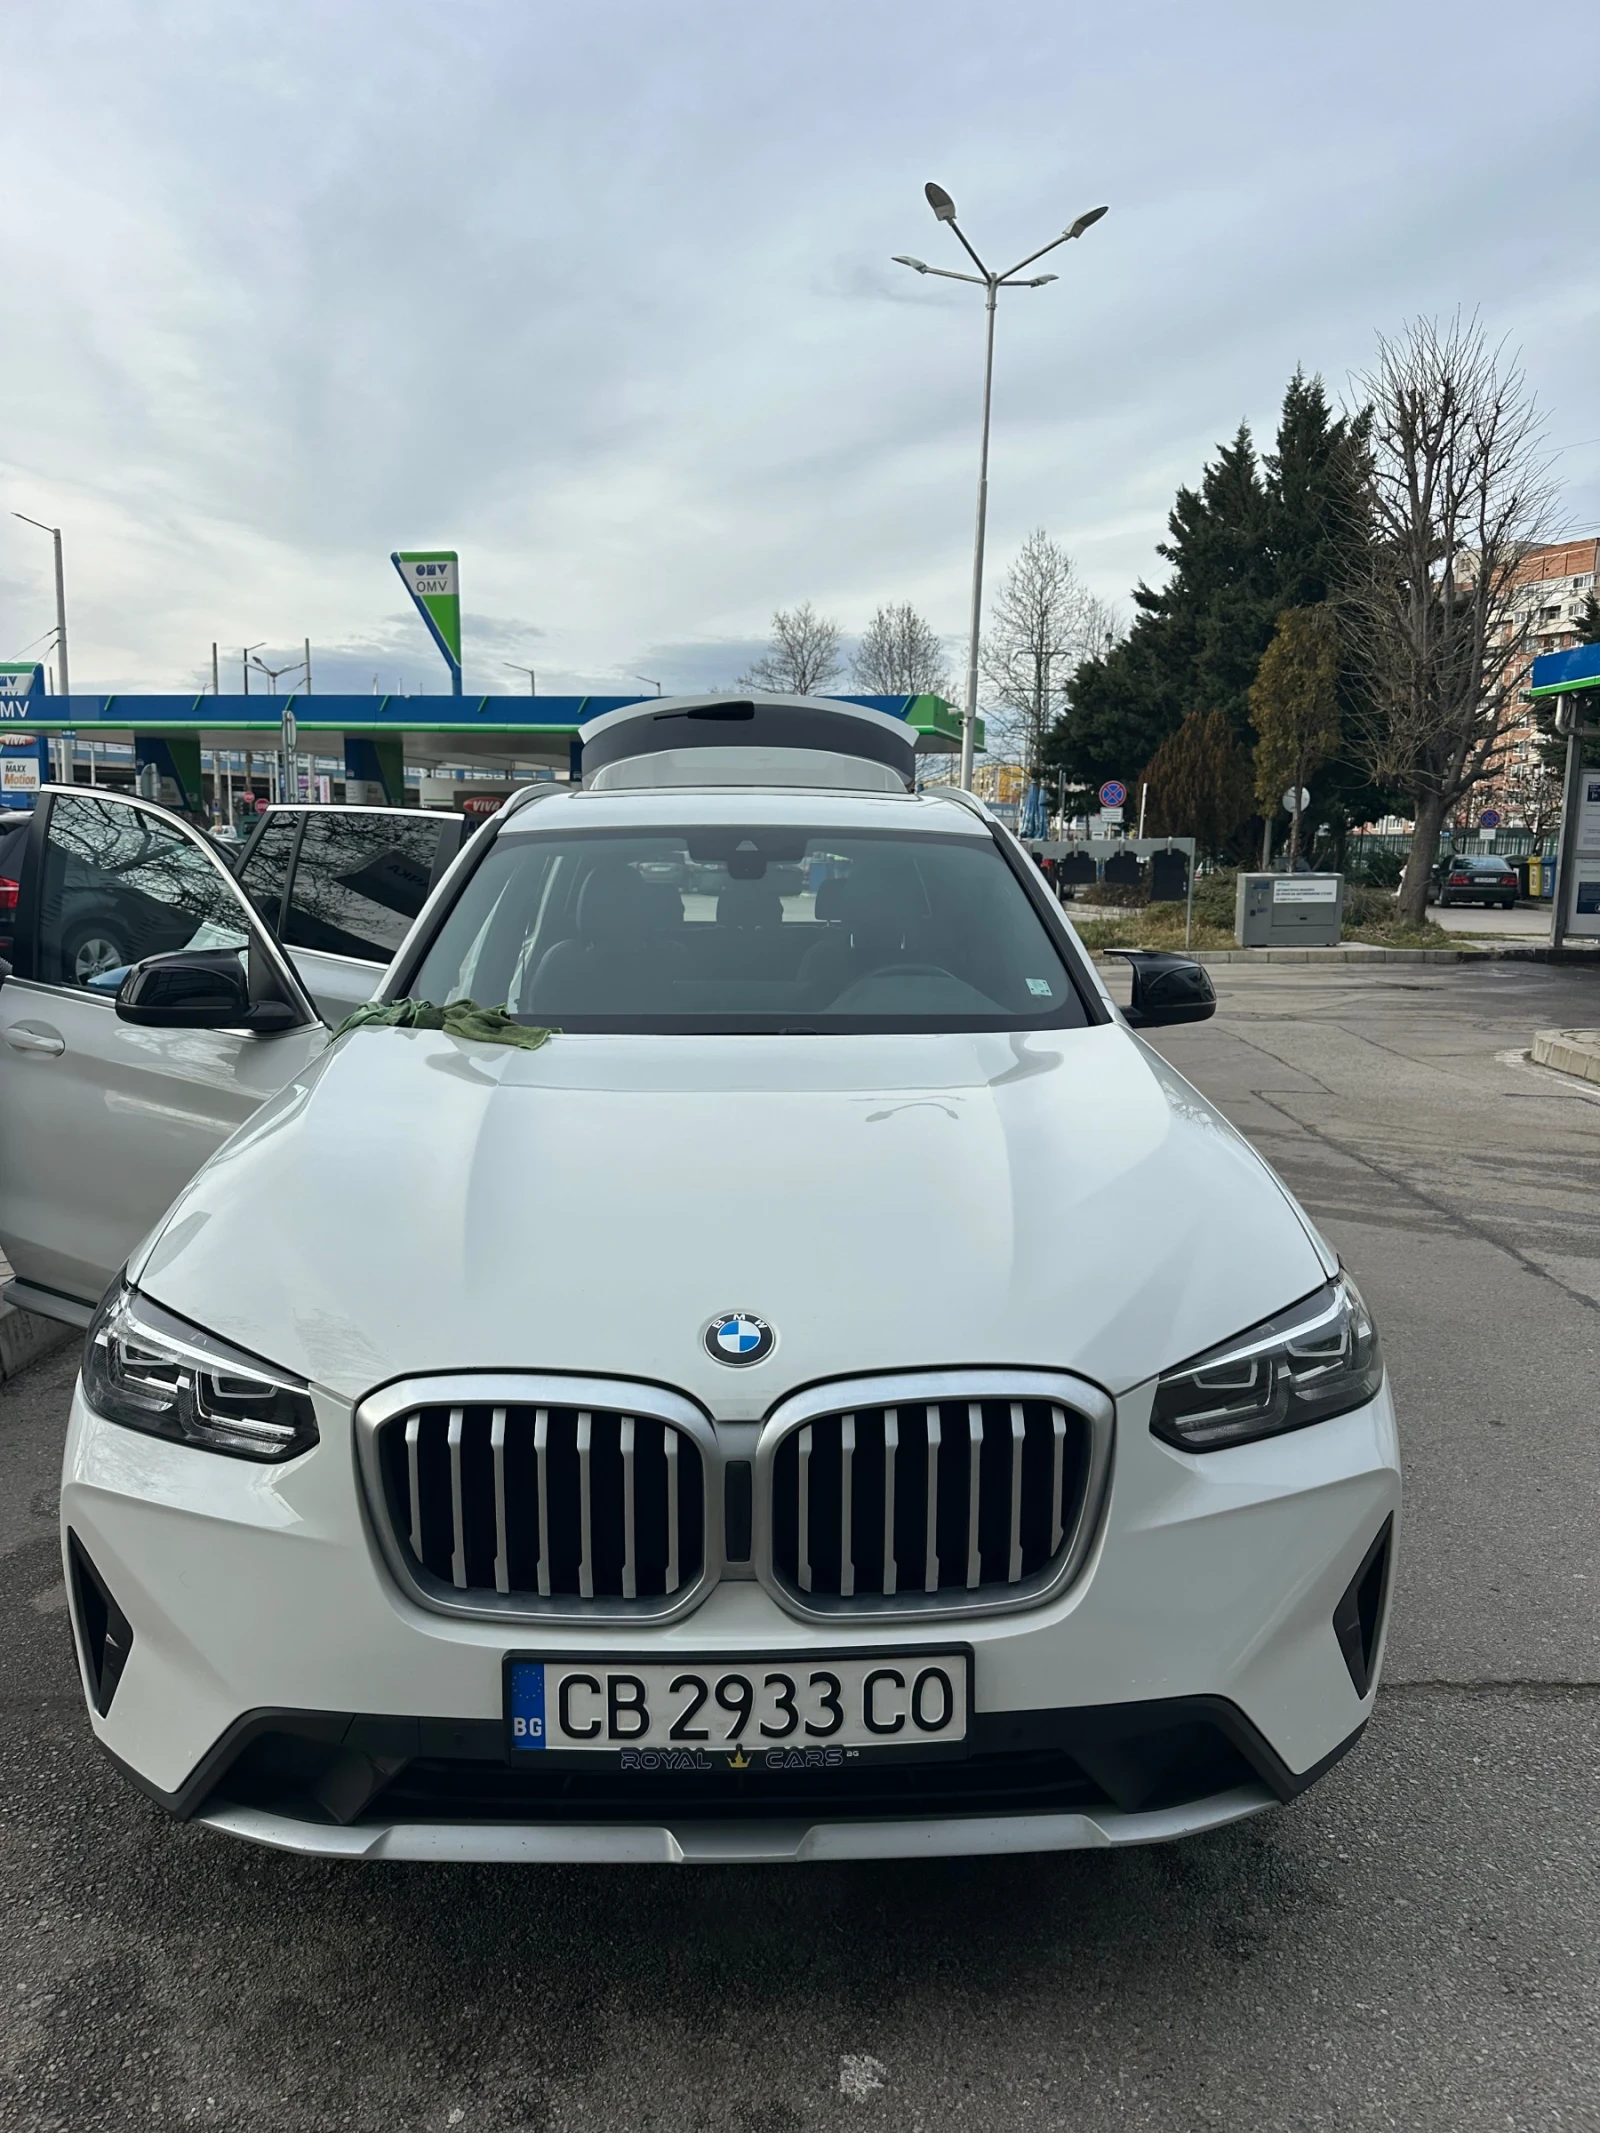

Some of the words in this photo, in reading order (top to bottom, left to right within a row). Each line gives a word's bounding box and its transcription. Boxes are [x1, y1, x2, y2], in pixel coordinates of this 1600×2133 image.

[416, 564, 448, 576] OMV
[416, 581, 448, 592] OMV
[5, 735, 27, 746] VIVA
[5, 764, 27, 773] MAXX
[4, 773, 37, 785] Motion
[472, 800, 500, 812] VIVA
[712, 1314, 768, 1329] BMW
[557, 1672, 650, 1741] CB
[668, 1670, 845, 1741] 2933
[862, 1666, 955, 1735] CO
[513, 1717, 543, 1737] BG
[620, 1749, 713, 1770] ROYAL
[765, 1748, 844, 1769] CARS
